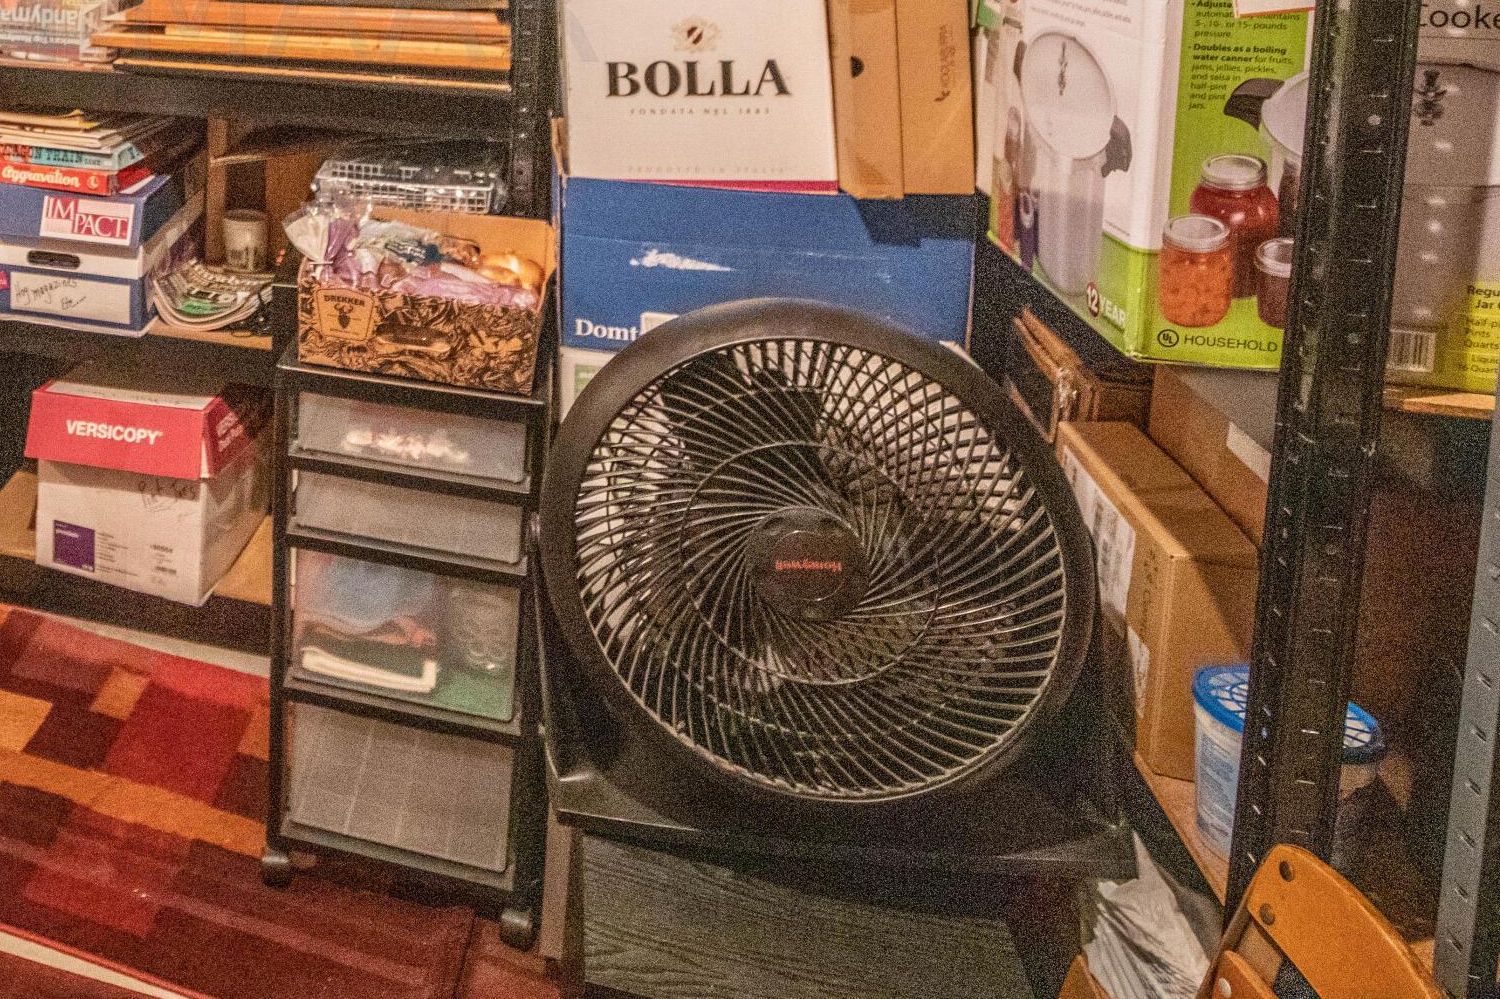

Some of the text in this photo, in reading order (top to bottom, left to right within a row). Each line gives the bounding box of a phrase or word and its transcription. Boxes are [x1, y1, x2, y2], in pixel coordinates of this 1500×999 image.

[1253, 22, 1288, 31] pounds
[1420, 4, 1500, 30] ooke
[1193, 44, 1231, 52] Doubles
[1253, 46, 1287, 55] boiling
[606, 59, 792, 98] BOLLA
[630, 107, 695, 115] FONDATA
[703, 107, 728, 116] NEL
[1087, 287, 1126, 326] 12 YEAR
[1475, 300, 1494, 309] Jar
[575, 317, 639, 342] Domt
[1162, 332, 1278, 352] UL HOUSEHOLD
[66, 419, 159, 446] VERSICOPY
